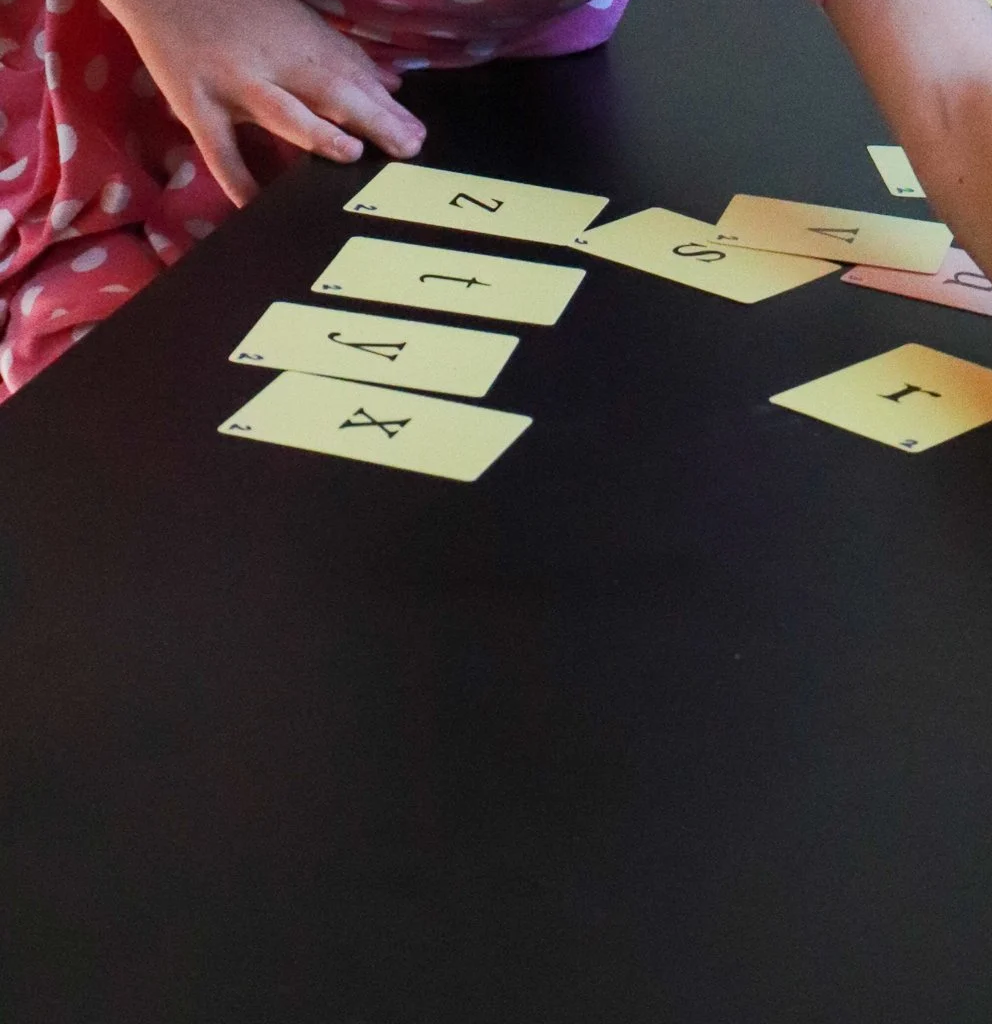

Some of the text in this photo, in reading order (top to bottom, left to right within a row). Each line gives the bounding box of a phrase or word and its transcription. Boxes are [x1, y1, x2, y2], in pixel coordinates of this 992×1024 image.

[353, 203, 378, 211] 2
[448, 192, 505, 213] z
[716, 233, 740, 241] 2
[807, 227, 860, 244] v
[672, 242, 727, 263] s
[418, 273, 492, 290] t
[327, 332, 407, 362] y
[237, 351, 264, 361] 2
[876, 382, 942, 403] r
[228, 422, 252, 431] 2
[338, 407, 412, 439] x
[899, 438, 919, 449] 2
